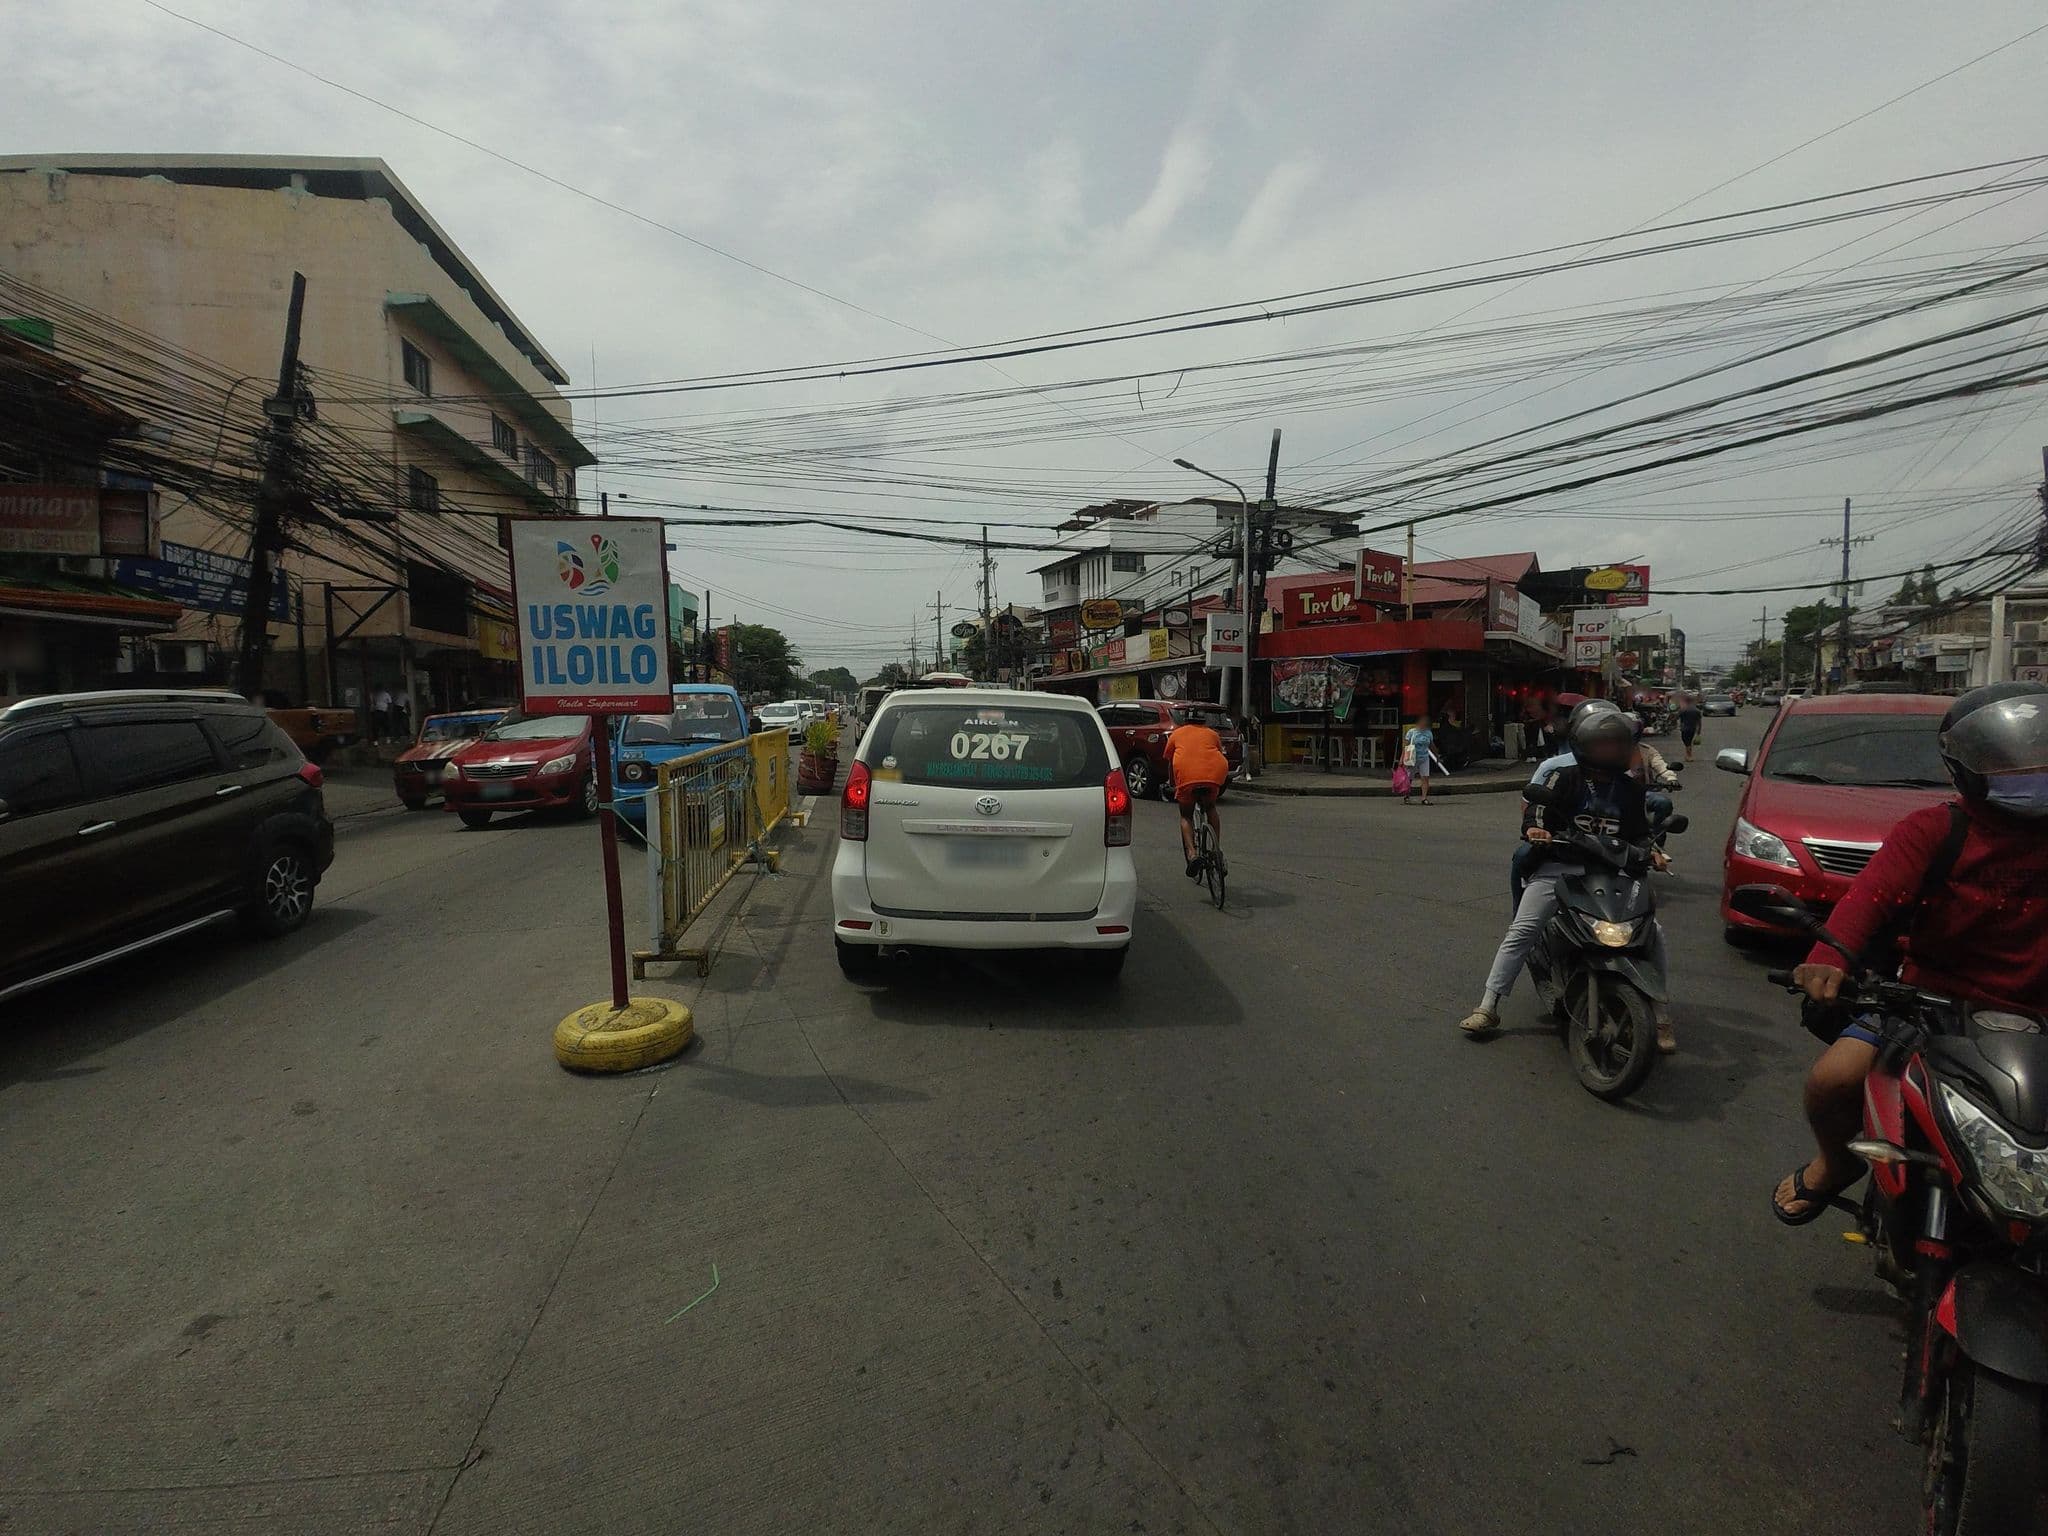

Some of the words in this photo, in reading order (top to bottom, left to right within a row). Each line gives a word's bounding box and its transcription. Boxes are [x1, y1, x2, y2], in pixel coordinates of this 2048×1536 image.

[1298, 592, 1330, 615] TRY
[529, 604, 656, 640] USWAG
[1578, 623, 1605, 634] TGP
[1214, 628, 1240, 641] TGP
[531, 644, 658, 686] ILOILO
[587, 698, 639, 709] Supermart
[963, 718, 1019, 726] AIRCN
[951, 732, 1030, 761] 0267
